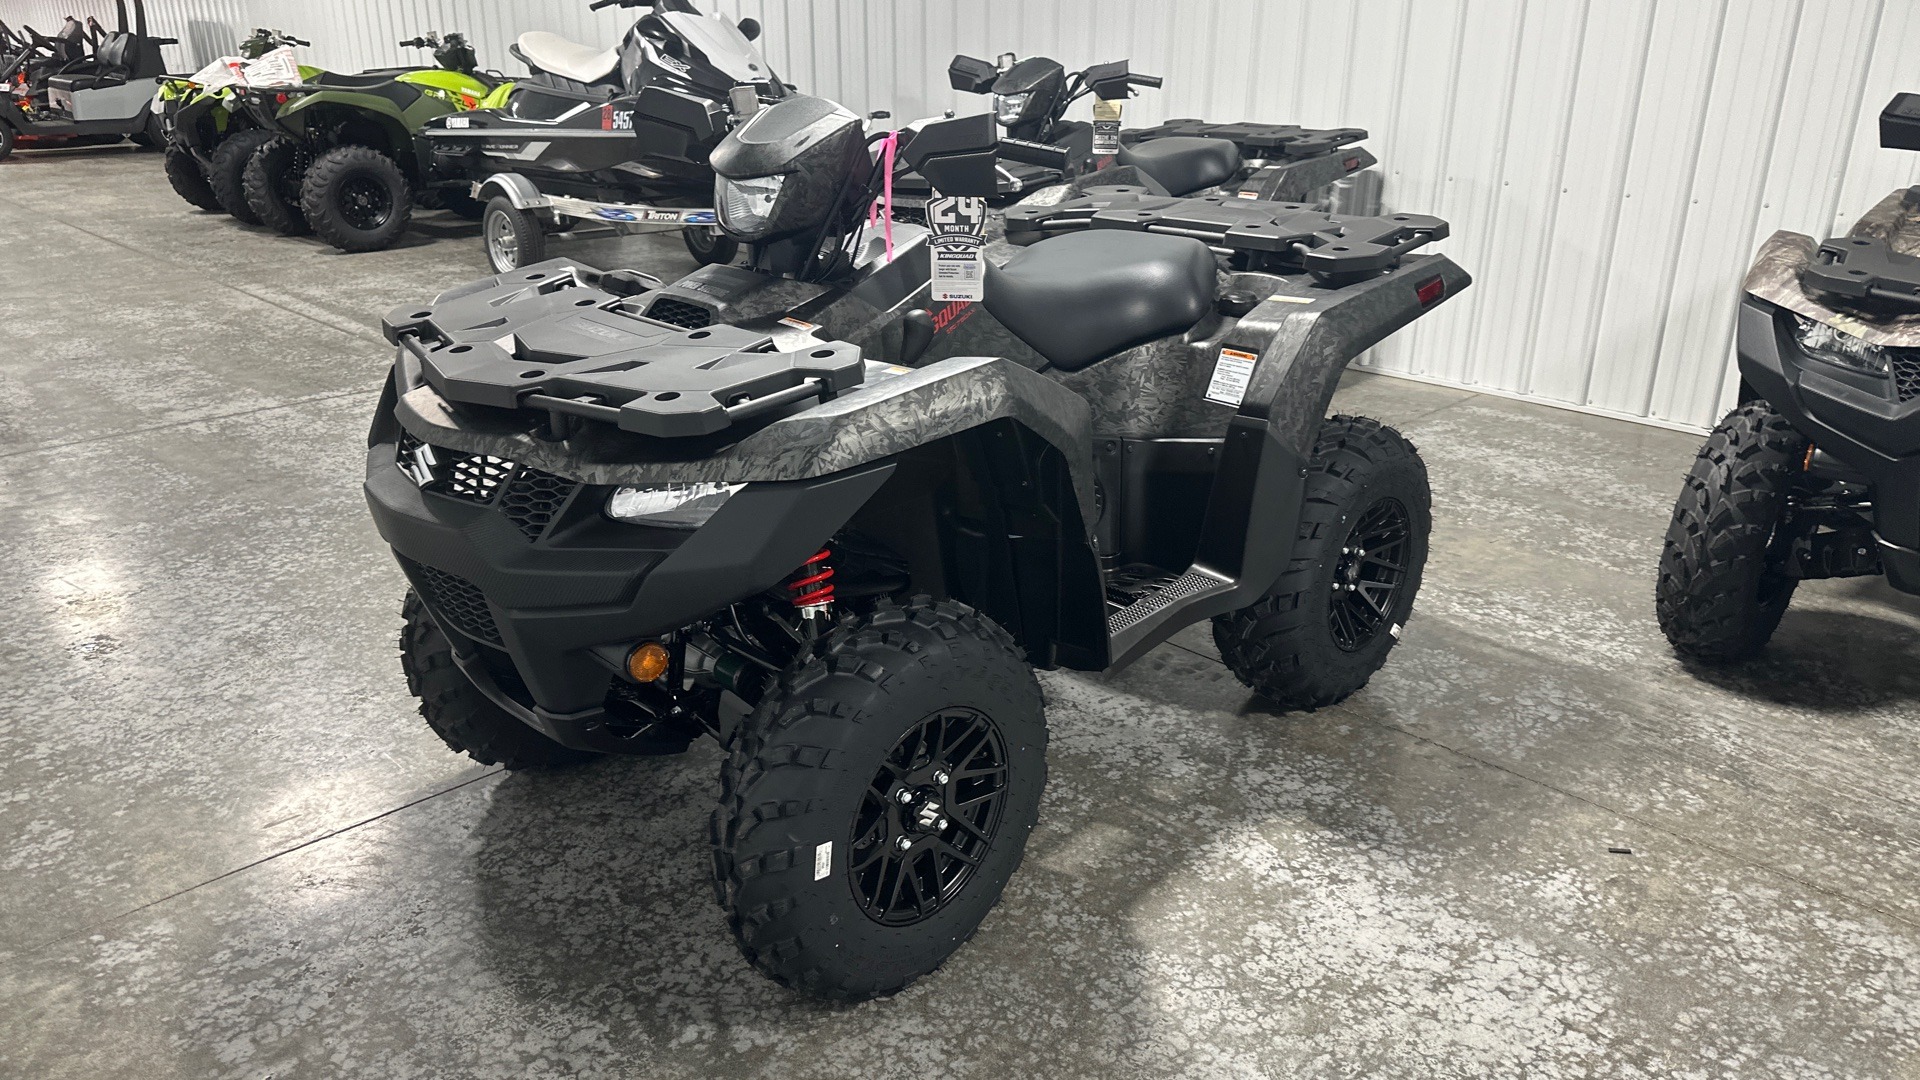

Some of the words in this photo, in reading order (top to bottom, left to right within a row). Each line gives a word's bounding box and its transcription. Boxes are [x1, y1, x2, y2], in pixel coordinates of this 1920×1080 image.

[461, 86, 481, 97] YAMAHA
[647, 210, 679, 221] TRITON
[934, 196, 981, 224] 24
[944, 224, 970, 233] MONTH
[933, 236, 954, 245] LIMITED
[954, 236, 980, 246] WARRANTY
